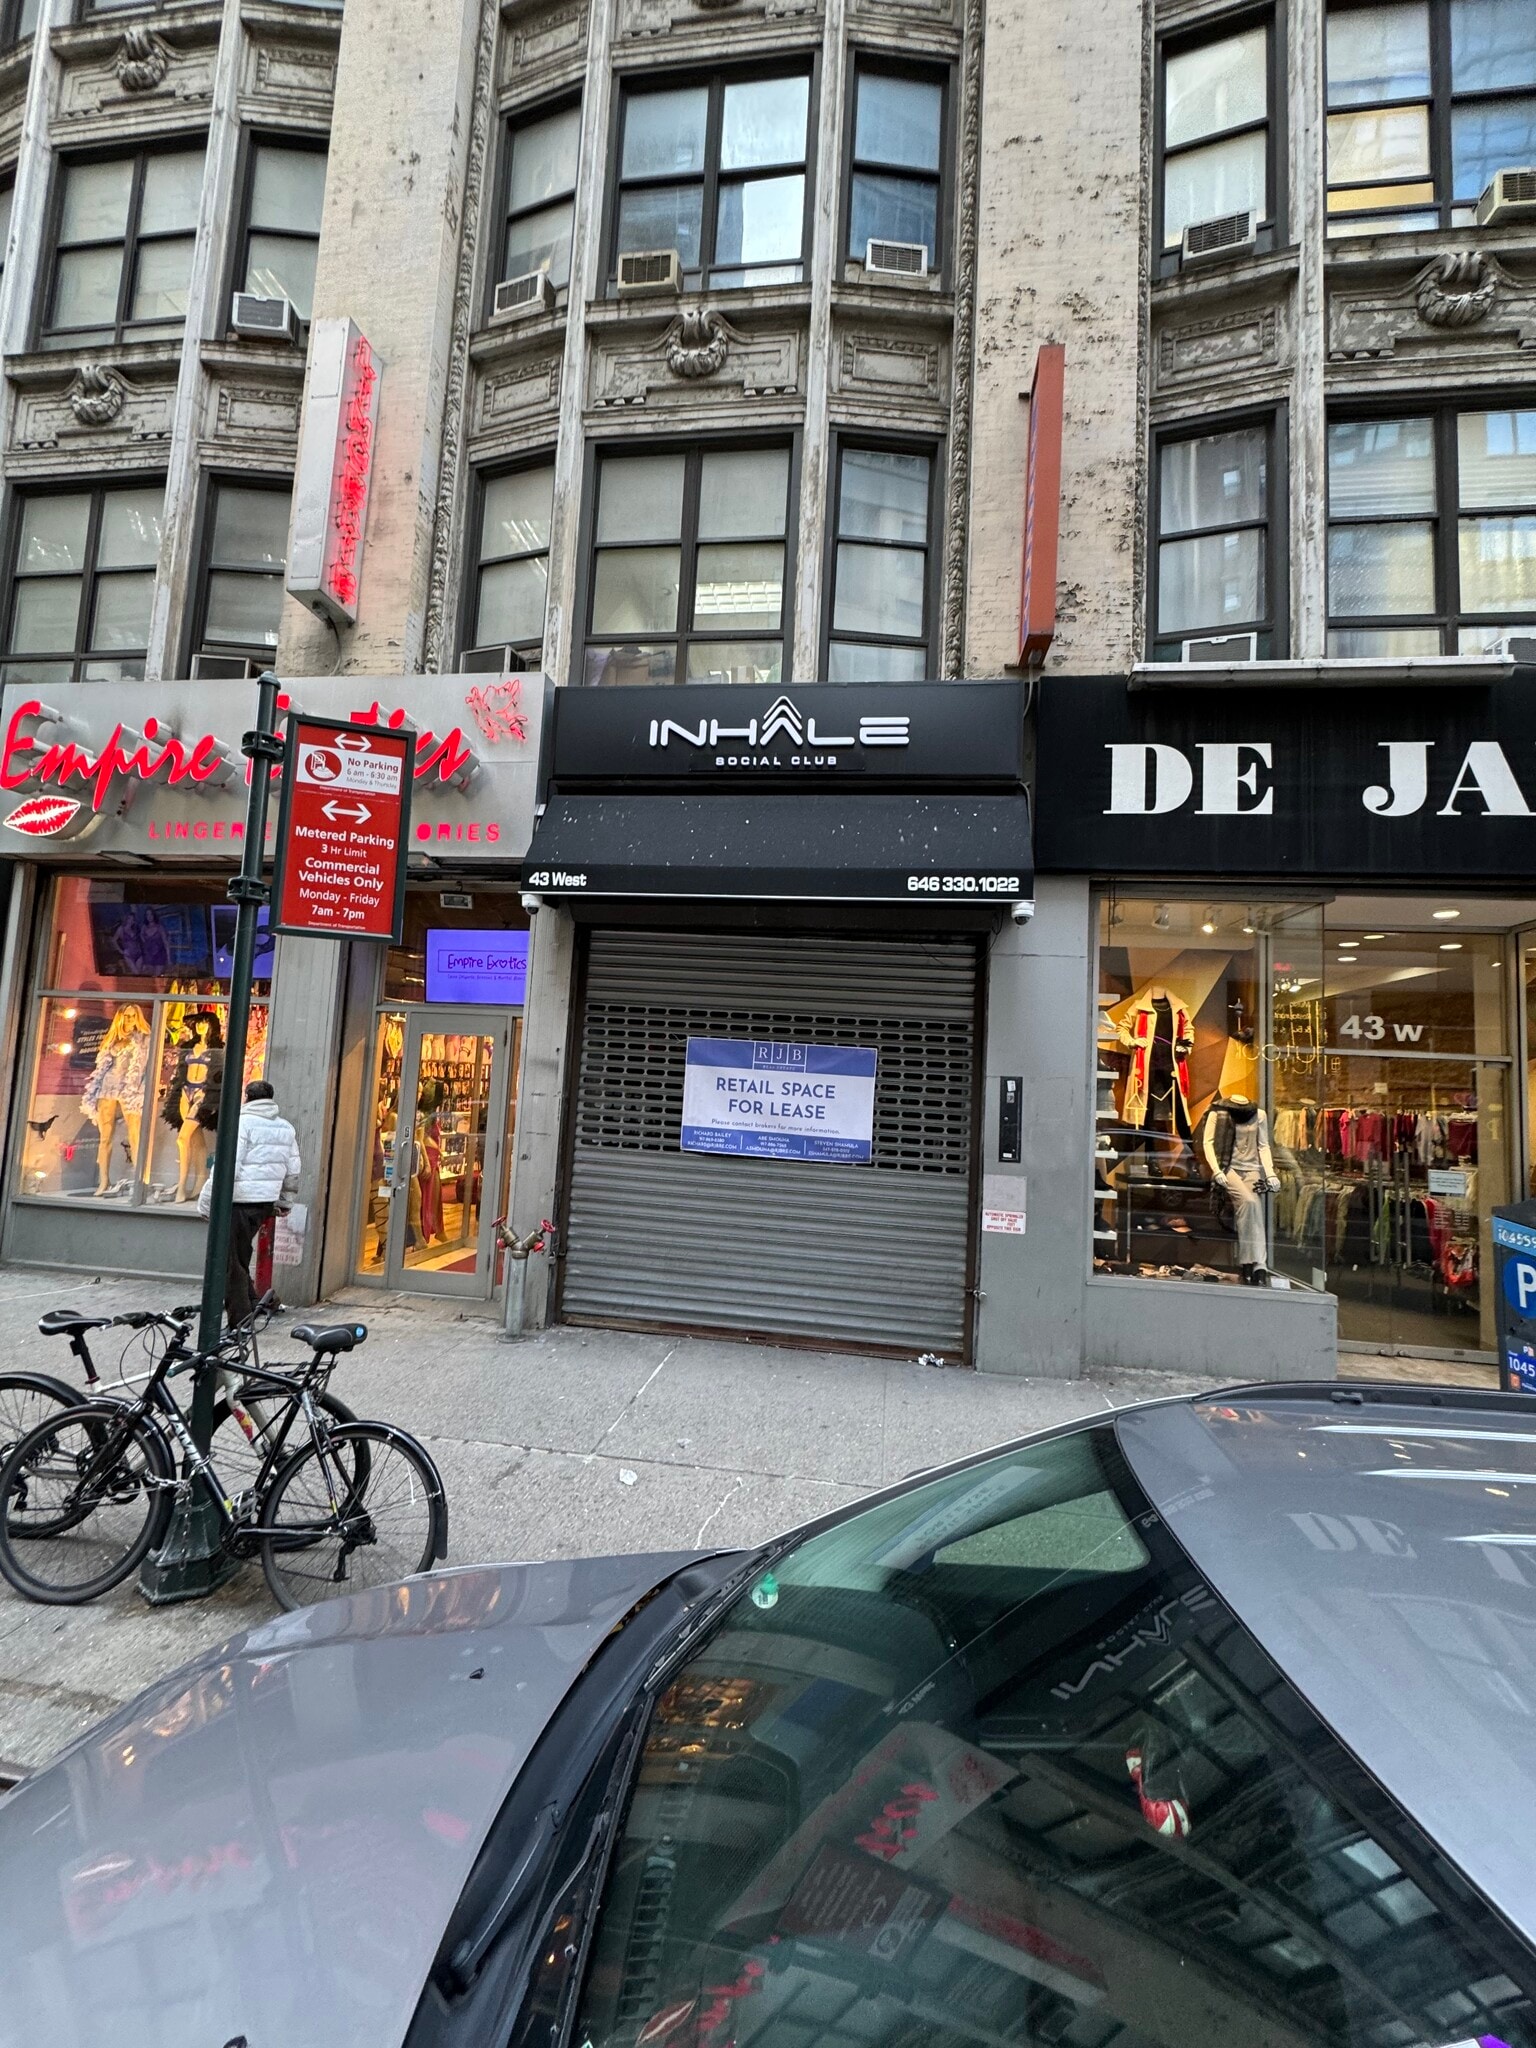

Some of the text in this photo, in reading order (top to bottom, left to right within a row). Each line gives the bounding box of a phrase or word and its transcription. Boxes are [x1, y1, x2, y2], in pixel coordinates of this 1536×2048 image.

[649, 696, 911, 747] INHALE
[0, 700, 222, 812] Empire
[347, 757, 400, 774] No Parking
[715, 756, 837, 767] SOCIAL CLUB
[370, 771, 386, 780] 6:30
[386, 774, 398, 782] am
[1103, 741, 1536, 817] DE JA
[295, 825, 394, 850] Metered Parking
[321, 844, 367, 858] 3 Hr Limit
[305, 857, 380, 875] Commercial
[298, 870, 384, 892] Vehicles Only
[528, 871, 587, 887] 43 West
[907, 876, 1020, 892] 646 330.1022
[299, 887, 341, 904] Monday
[349, 892, 380, 908] Friday
[311, 904, 334, 917] 7am
[342, 907, 365, 920] 7pm
[447, 953, 484, 970] Empire
[1339, 1014, 1386, 1040] 43
[716, 1077, 836, 1099] RETAIL SPACE
[728, 1098, 826, 1120] FOR LEASE
[711, 1118, 730, 1126] Please
[731, 1120, 754, 1128] contact
[754, 1122, 776, 1130] brokers
[1517, 1262, 1536, 1309] P
